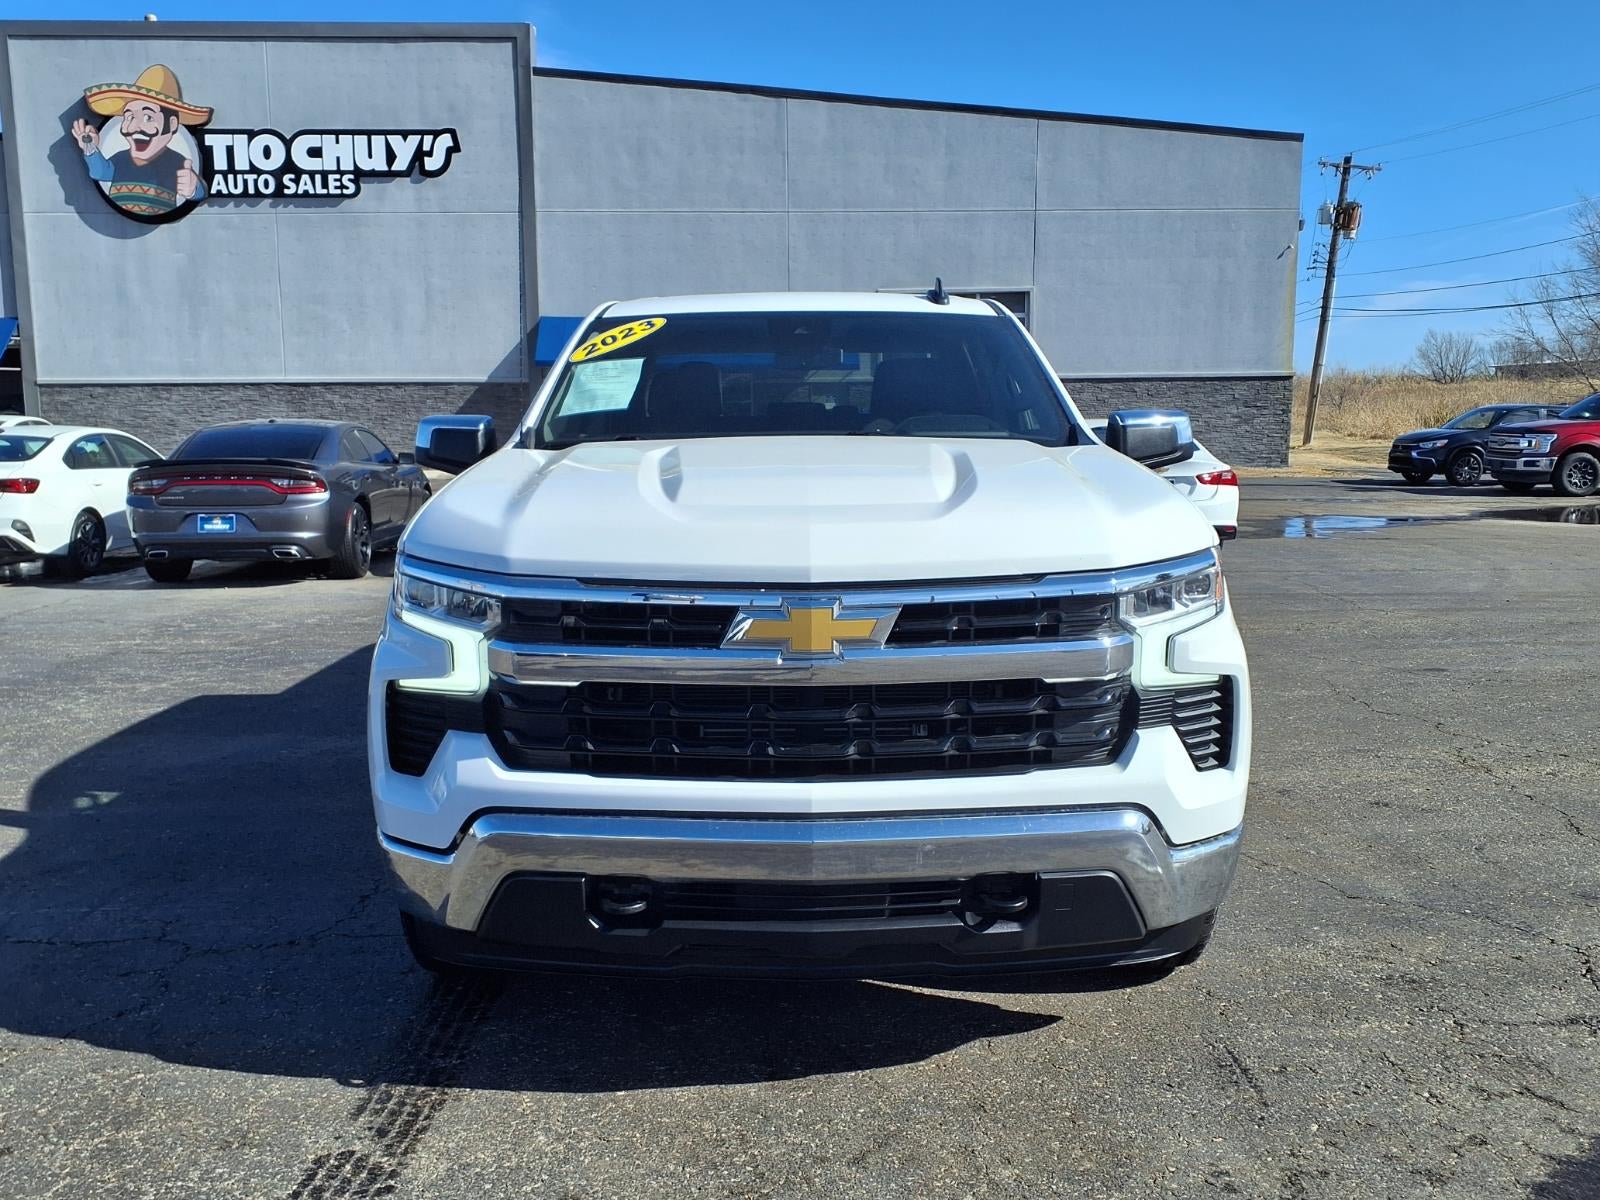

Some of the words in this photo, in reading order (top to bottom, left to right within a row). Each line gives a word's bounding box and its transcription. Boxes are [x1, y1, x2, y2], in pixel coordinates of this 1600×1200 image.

[205, 134, 286, 171] TIO
[291, 133, 454, 173] CHUY'S
[211, 174, 276, 195] AUTO
[283, 173, 356, 195] SALES
[581, 320, 657, 357] 2023
